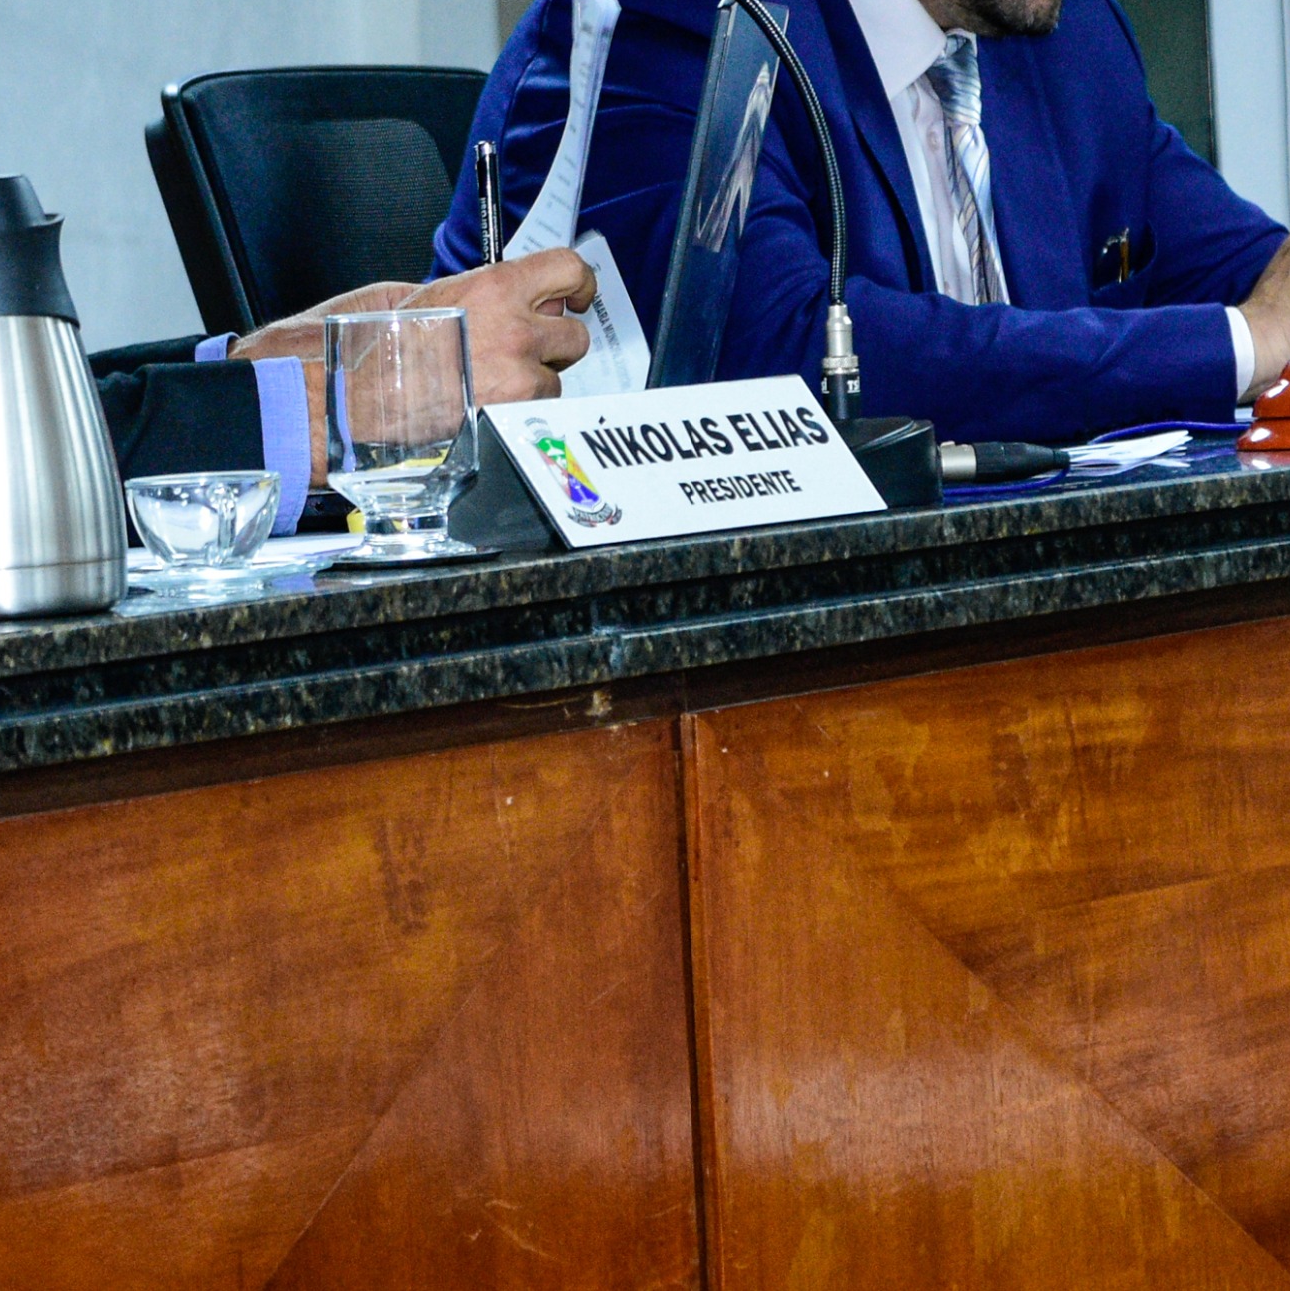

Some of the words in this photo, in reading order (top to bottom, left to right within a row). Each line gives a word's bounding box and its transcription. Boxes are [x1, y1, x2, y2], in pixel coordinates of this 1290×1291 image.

[592, 293, 610, 327] ÂMARA
[580, 416, 733, 468] NÍKOLAS
[726, 407, 830, 452] ELIAS
[678, 469, 802, 505] PRESIDENTE
